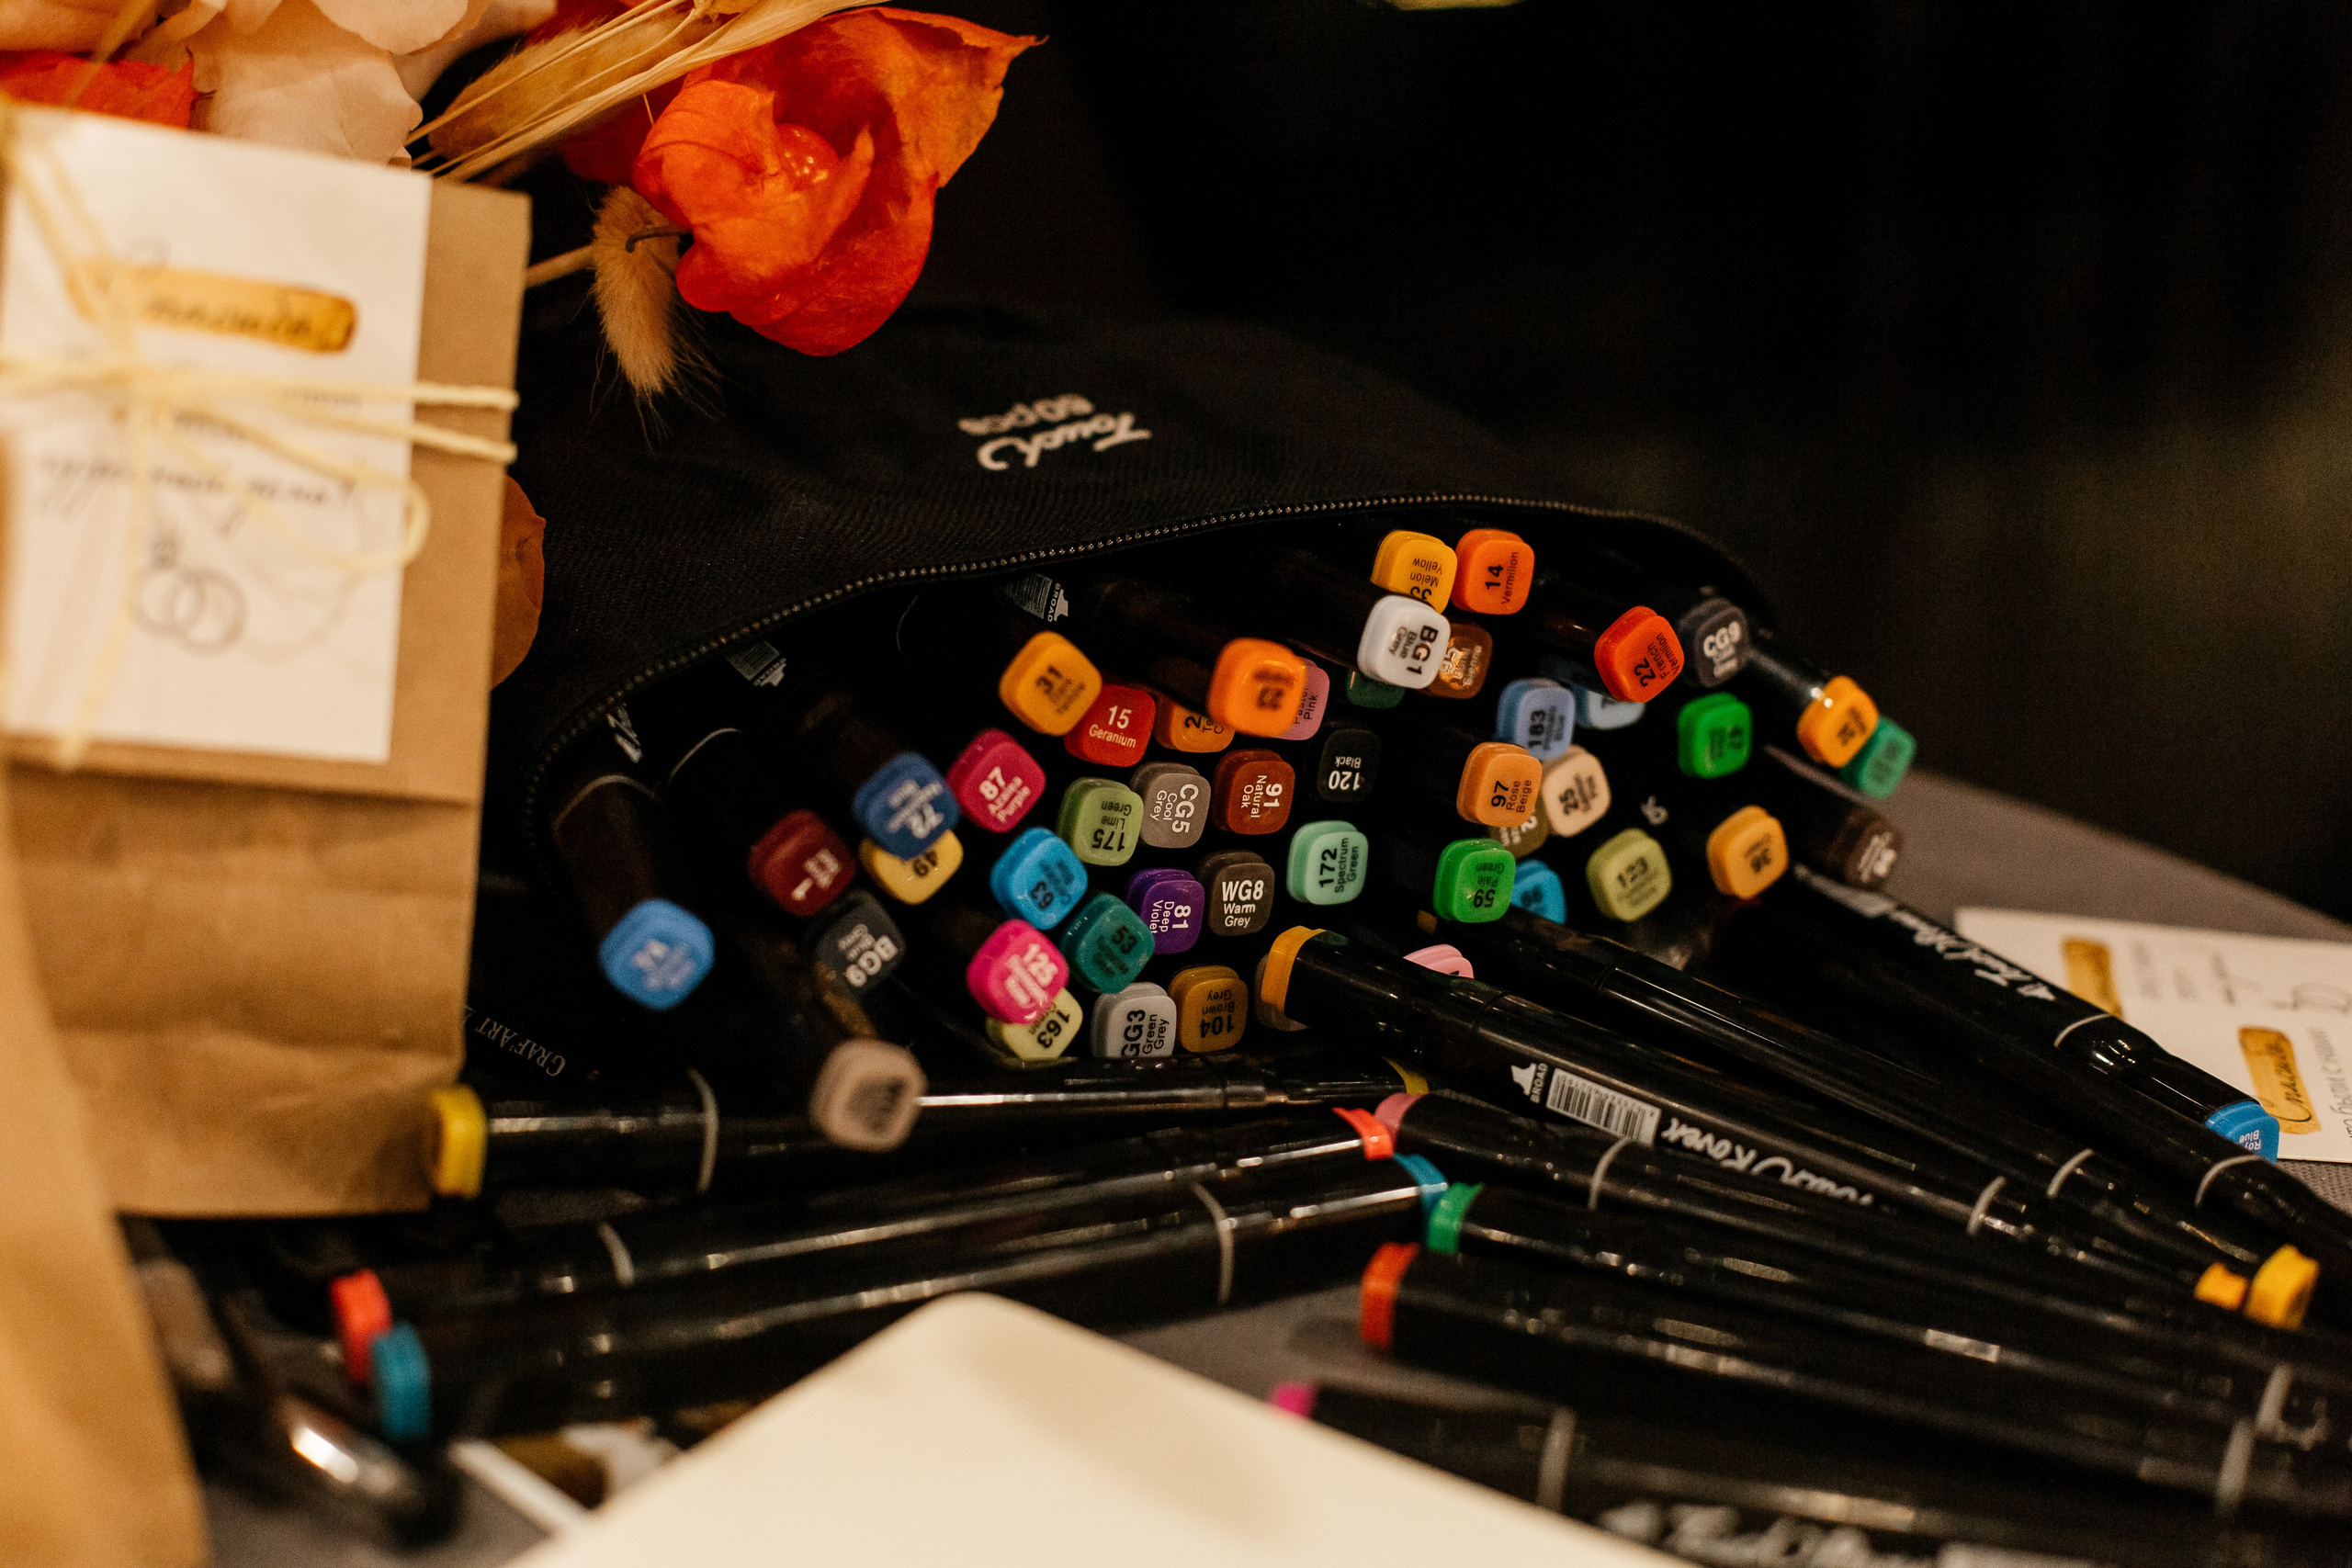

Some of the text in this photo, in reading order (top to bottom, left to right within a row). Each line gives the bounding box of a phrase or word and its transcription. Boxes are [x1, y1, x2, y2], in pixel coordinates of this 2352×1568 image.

[977, 412, 1152, 470] Touch
[1409, 570, 1440, 588] Melon
[1411, 557, 1442, 574] Yellow
[1484, 564, 1504, 590] 14
[1501, 551, 1519, 604] Vermilion
[1046, 582, 1061, 624] BROAD
[1388, 626, 1408, 658] Grey
[1399, 631, 1417, 659] Blue
[1407, 626, 1439, 675] BG1
[1657, 632, 1680, 675] Vermilion
[1703, 622, 1741, 658] CG9
[1634, 658, 1656, 687] 22
[1648, 642, 1668, 680] French
[1108, 705, 1132, 729] 15
[1304, 694, 1318, 720] Pink
[1089, 724, 1136, 749] Geranium
[1528, 709, 1545, 750] 183
[1335, 755, 1362, 769] Black
[978, 766, 1006, 801] 87
[1329, 770, 1361, 791] 120
[1490, 780, 1509, 807] 97
[997, 785, 1031, 823] Purple
[1102, 800, 1132, 816] Green
[1150, 790, 1167, 821] Grey
[1162, 793, 1178, 820] Cool
[1171, 784, 1199, 833] CG5
[1241, 784, 1254, 808] Oak
[1250, 774, 1267, 818] Natural
[1263, 783, 1283, 808] 91
[1506, 780, 1521, 811] Rose
[1516, 779, 1532, 813] Beige
[1101, 816, 1125, 829] Lime
[1091, 829, 1125, 852] 175
[1318, 848, 1337, 889] 172
[1335, 837, 1349, 893] Spectrum
[1347, 845, 1359, 883] Green
[1476, 862, 1505, 874] Green
[1030, 881, 1054, 909] 63
[1222, 879, 1264, 902] WG8
[1476, 876, 1498, 887] Pale
[1224, 902, 1256, 915] Warm
[1473, 889, 1495, 908] 59
[1148, 899, 1163, 934] Violet
[1159, 900, 1175, 932] Deep
[1171, 905, 1192, 930] 81
[1225, 915, 1250, 929] Grey
[1111, 924, 1137, 953] 53
[845, 934, 899, 987] BG9
[1022, 943, 1058, 986] 125
[1202, 1000, 1235, 1015] Brown
[1207, 988, 1232, 1001] Grey
[1037, 1007, 1070, 1049] 163
[1121, 1010, 1146, 1056] GG3
[1142, 1014, 1158, 1055] Green
[1154, 1018, 1170, 1050] Grey
[1199, 1015, 1235, 1039] 104
[1529, 1062, 1548, 1104] BROAD
[2239, 1130, 2260, 1144] Blue
